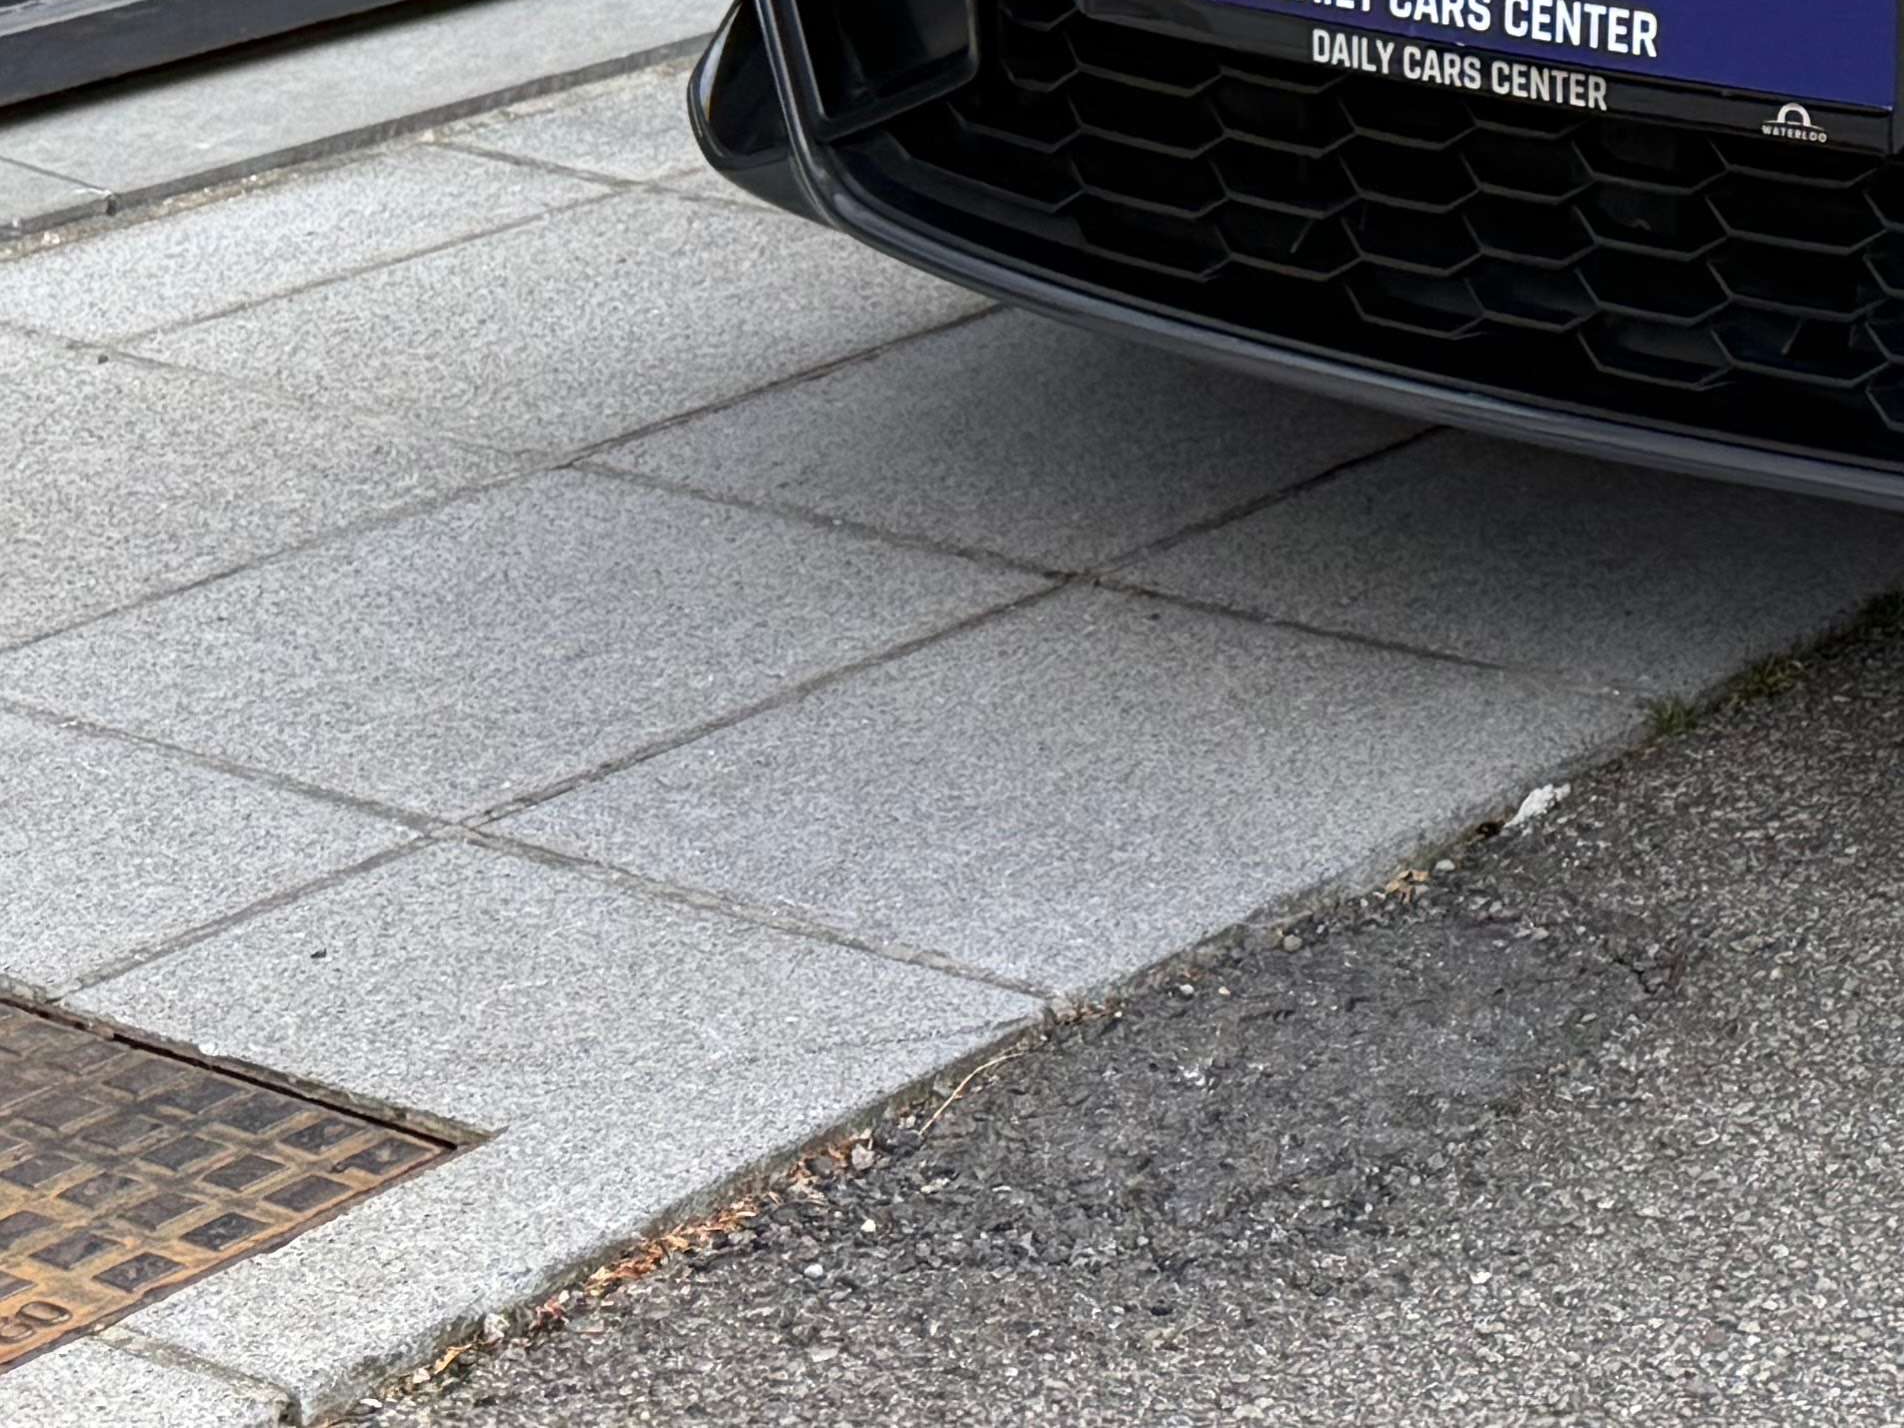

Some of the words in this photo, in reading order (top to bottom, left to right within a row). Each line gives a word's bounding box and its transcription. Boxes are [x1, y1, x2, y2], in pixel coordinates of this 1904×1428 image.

[1312, 28, 1396, 75] DAILY
[1403, 44, 1482, 90] CARS
[1491, 59, 1608, 112] CENTER
[1761, 124, 1828, 143] WATERLOO
